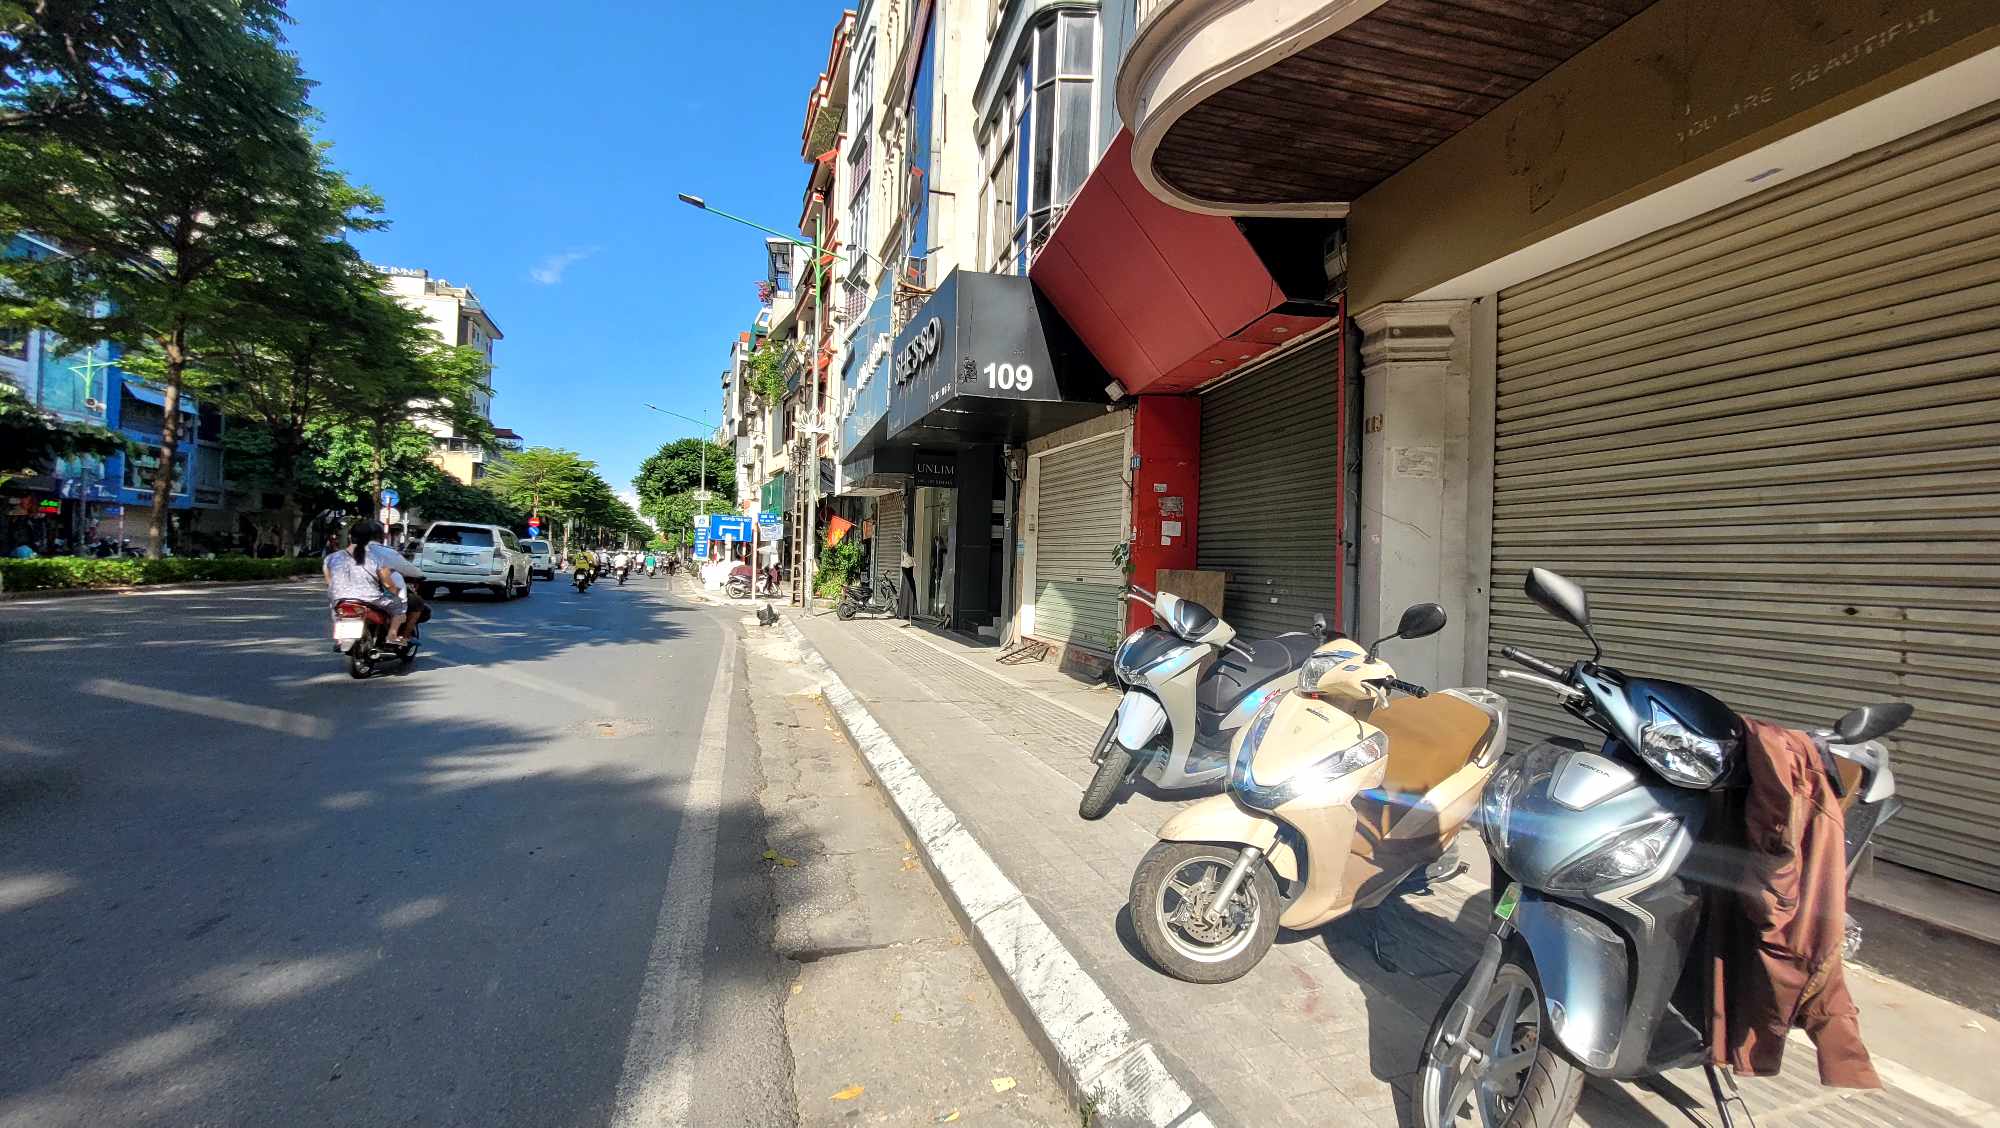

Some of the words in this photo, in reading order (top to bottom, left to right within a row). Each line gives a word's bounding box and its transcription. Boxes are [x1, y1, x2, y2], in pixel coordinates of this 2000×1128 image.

[895, 316, 942, 386] SHESSO
[983, 362, 1034, 392] 109
[917, 463, 954, 475] UNLIM
[1576, 761, 1610, 778] HONDA
